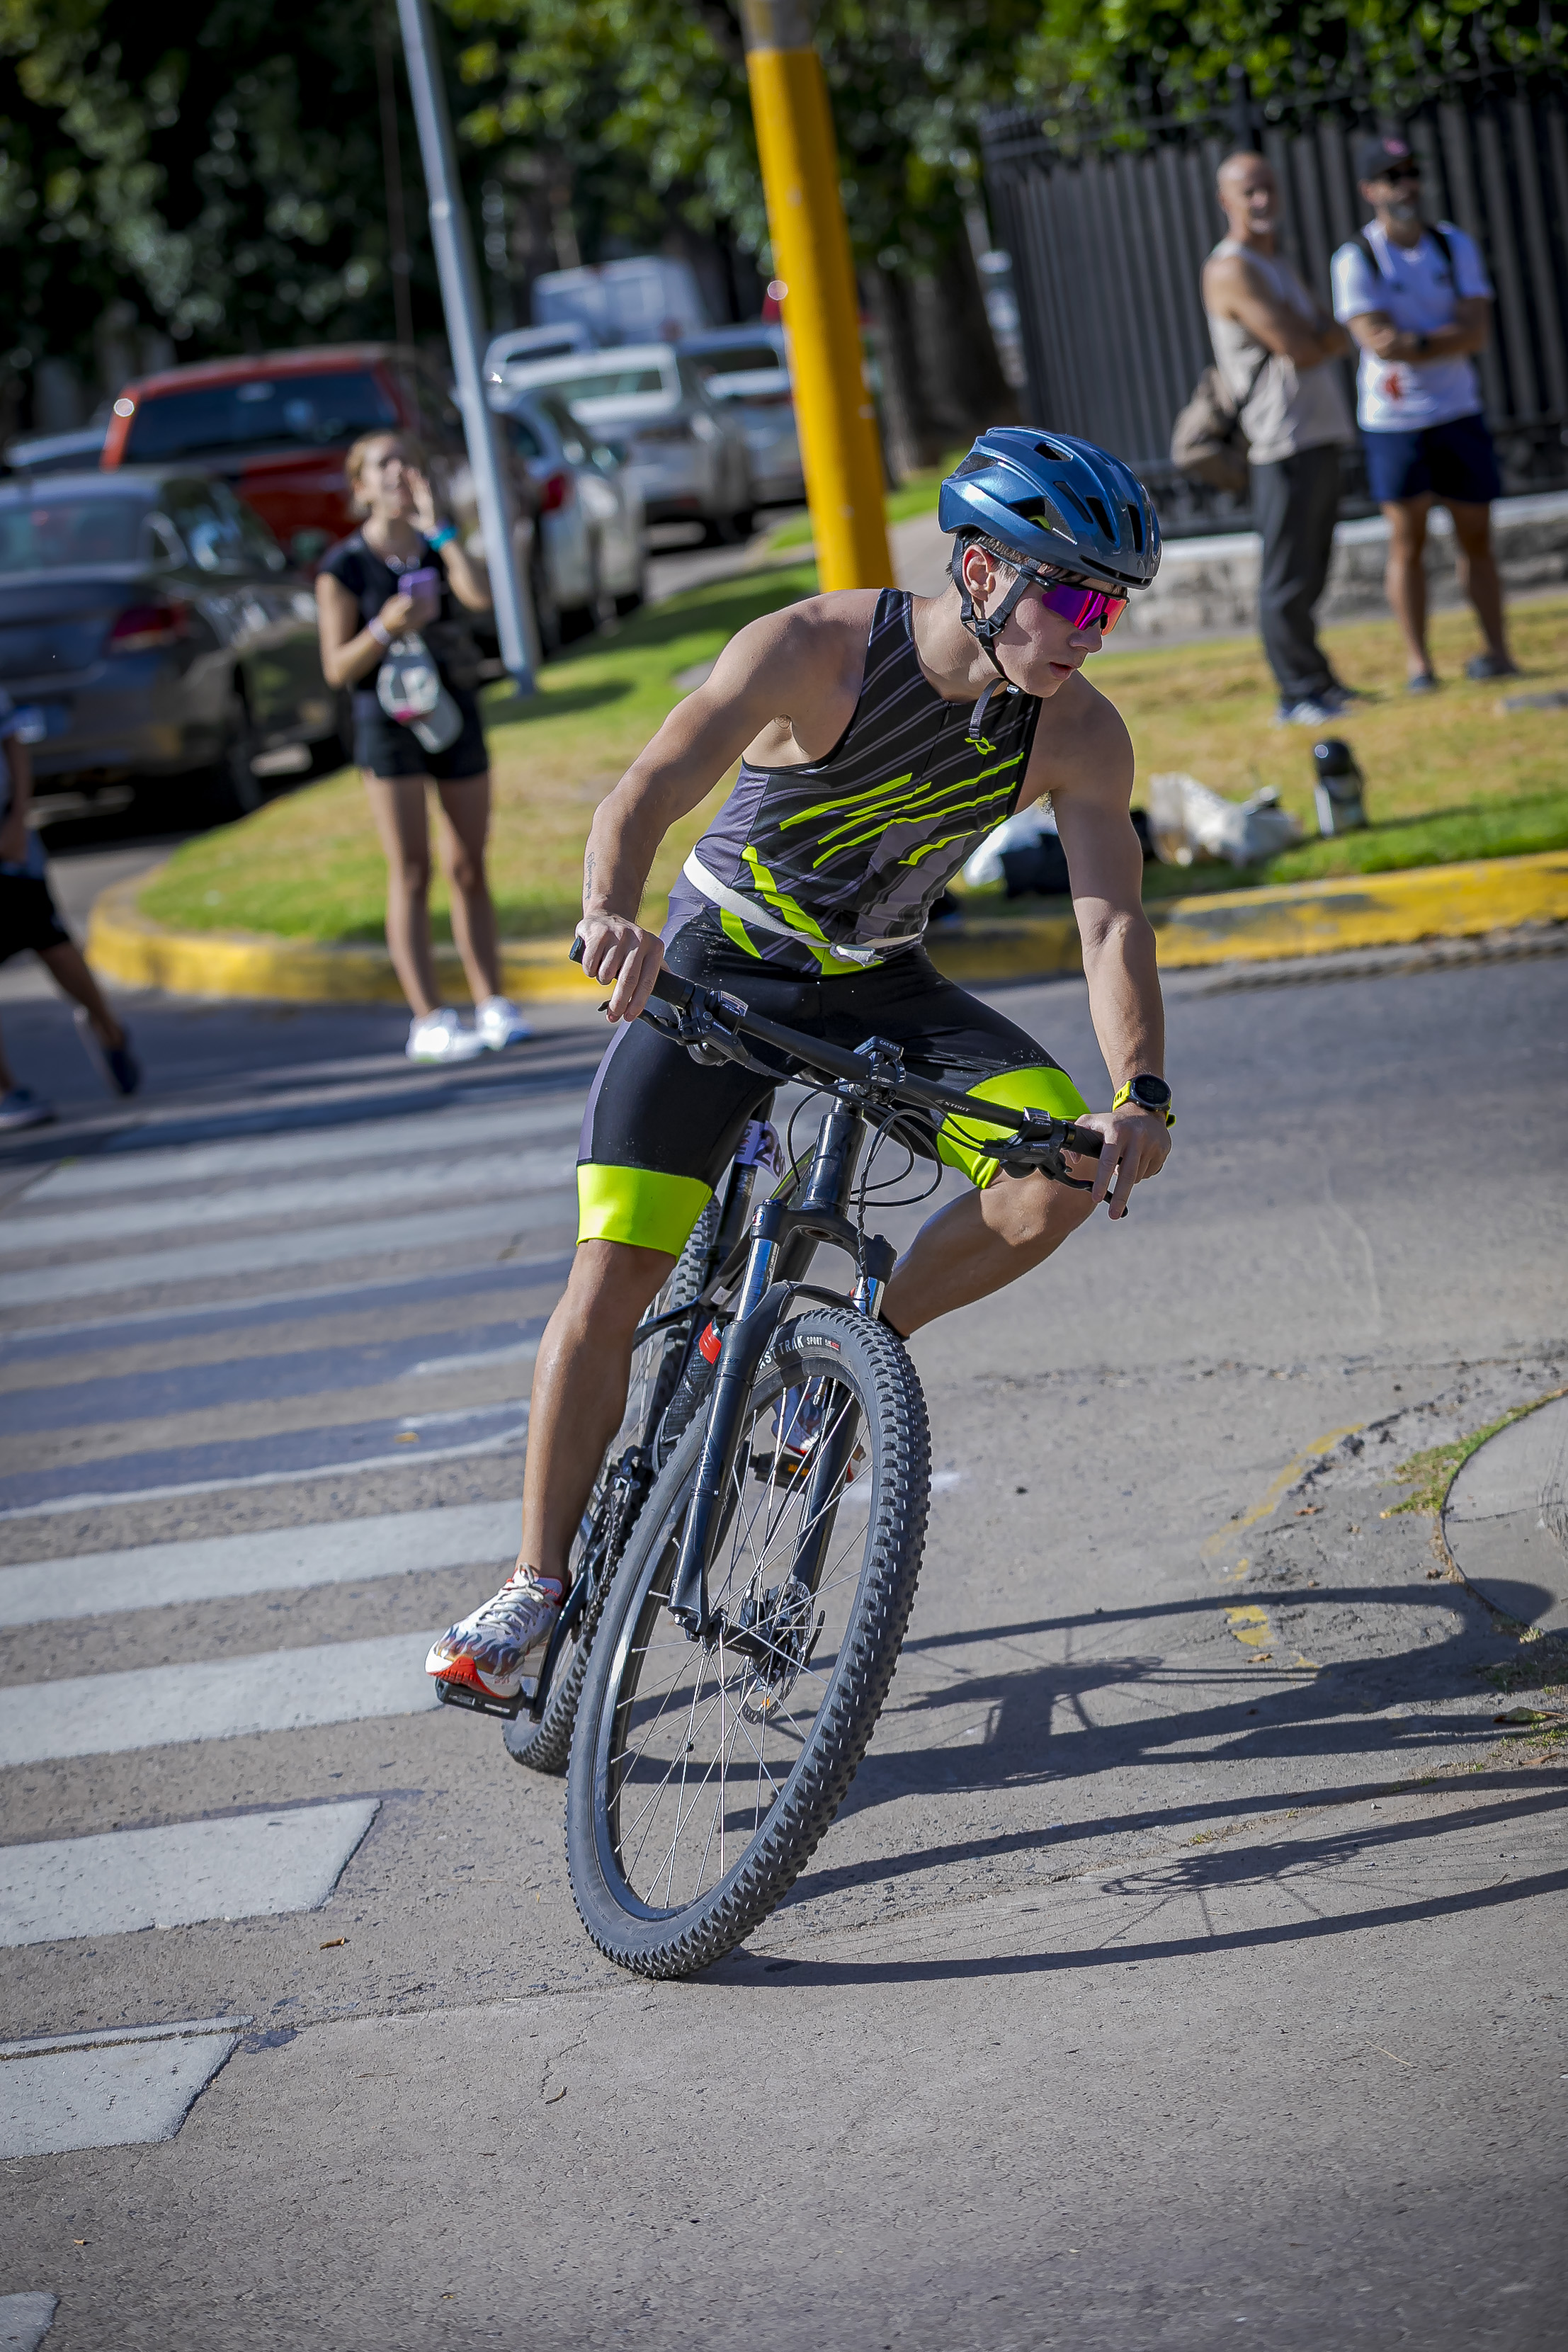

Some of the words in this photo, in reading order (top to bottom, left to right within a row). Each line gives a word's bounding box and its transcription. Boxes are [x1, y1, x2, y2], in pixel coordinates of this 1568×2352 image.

[879, 1040, 900, 1052] CATEYE
[778, 1334, 805, 1355] TRAK
[806, 1336, 823, 1346] SPORT
